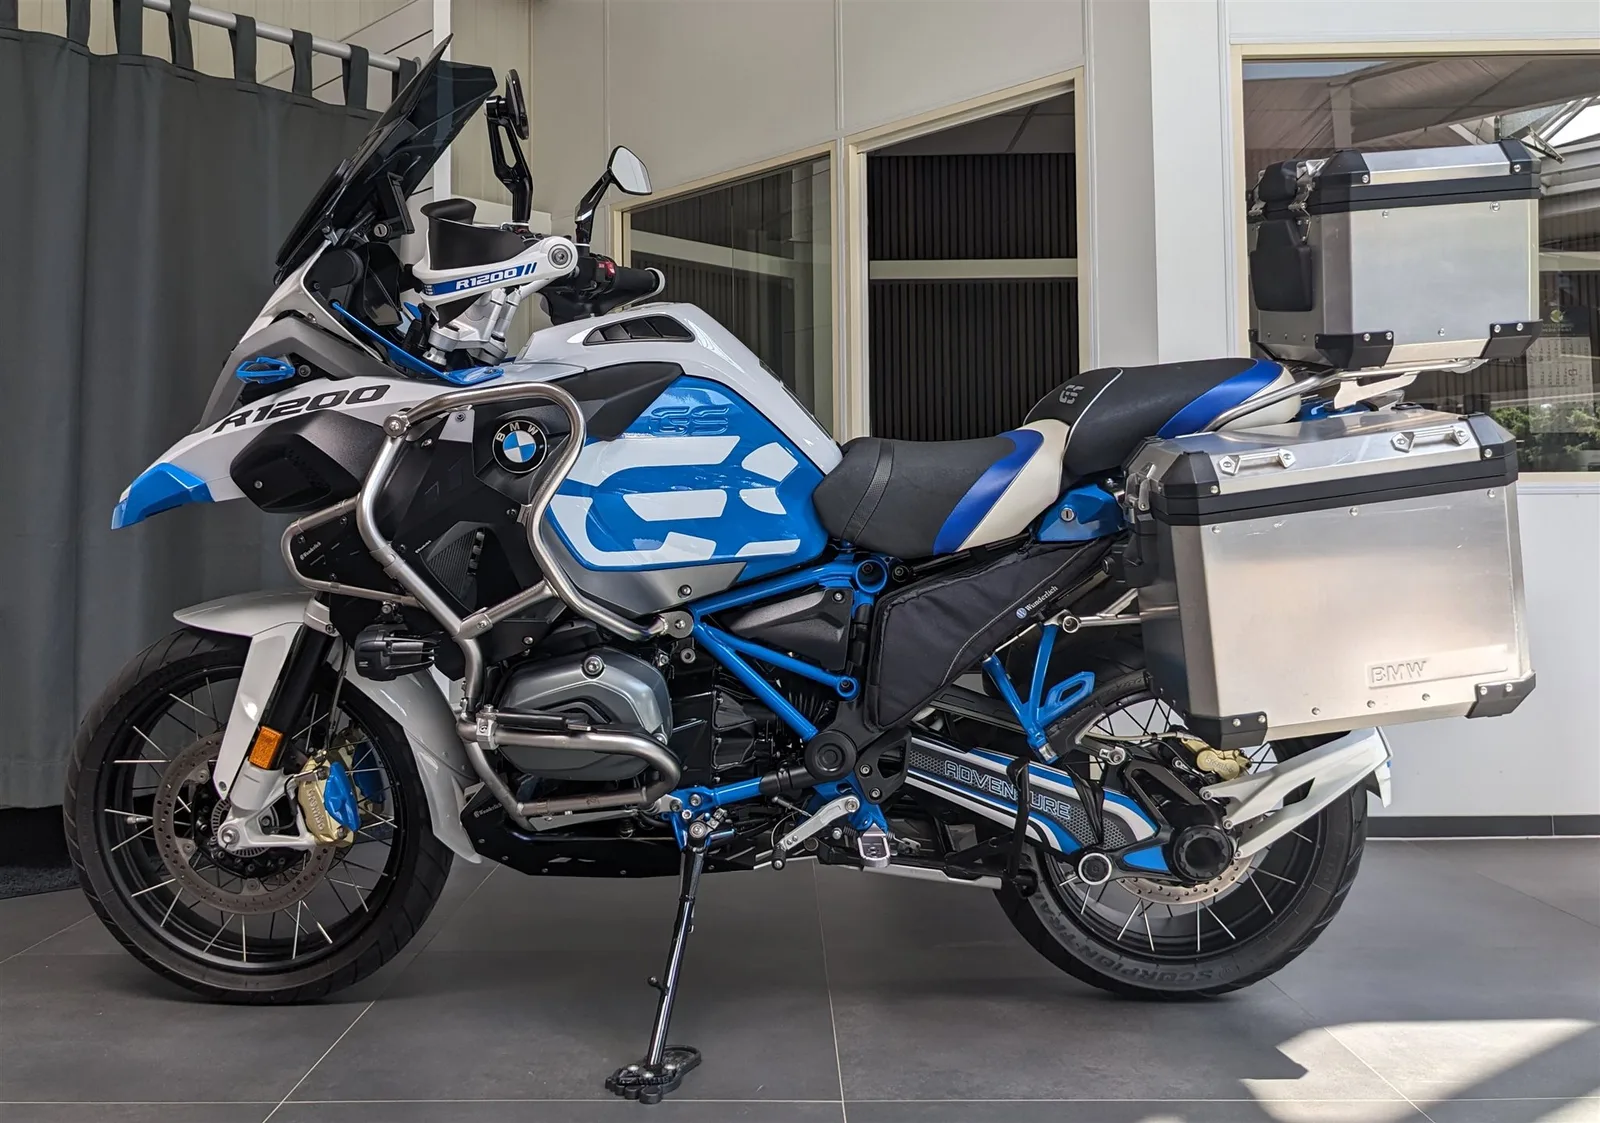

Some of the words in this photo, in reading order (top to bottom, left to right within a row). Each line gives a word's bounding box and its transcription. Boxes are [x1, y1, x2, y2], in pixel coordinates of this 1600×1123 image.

[455, 267, 528, 291] R1200
[212, 384, 391, 434] R1200
[495, 421, 539, 443] BMW
[1024, 585, 1059, 612] Wunderlich
[1371, 660, 1427, 684] BMW
[944, 759, 1072, 820] ADVENURE
